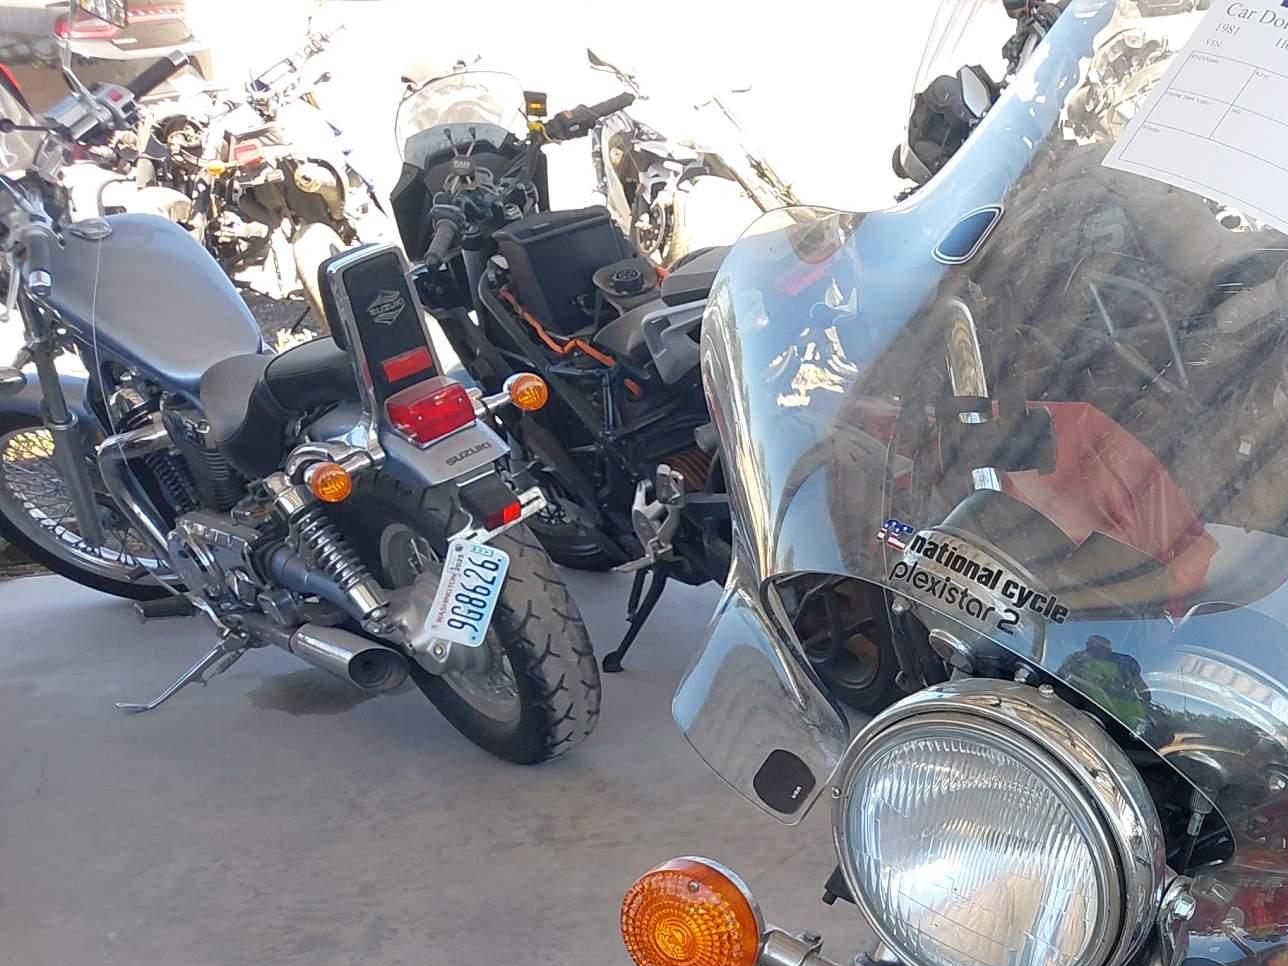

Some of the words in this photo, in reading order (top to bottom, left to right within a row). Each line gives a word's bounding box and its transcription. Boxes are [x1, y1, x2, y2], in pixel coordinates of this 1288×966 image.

[1215, 22, 1240, 36] 1981
[1226, 2, 1255, 20] Car
[446, 442, 493, 466] SUZUKI
[447, 557, 500, 633] 9G8626
[888, 560, 996, 622] plexistar
[997, 608, 1020, 635] 2
[910, 534, 1003, 591] national
[1002, 578, 1069, 625] cycle
